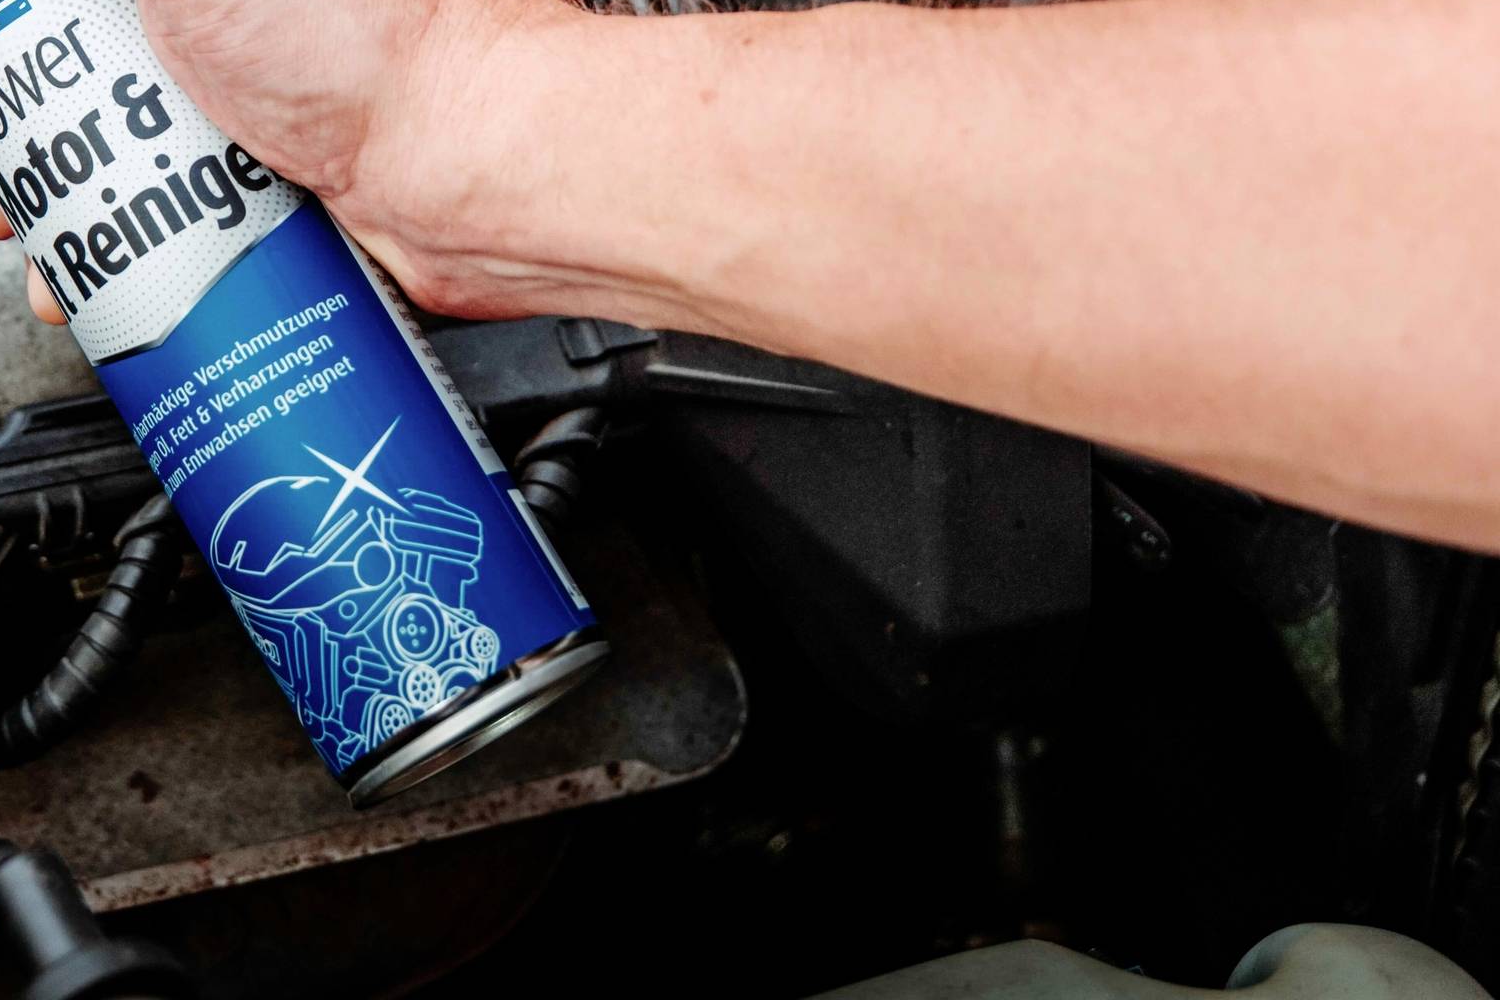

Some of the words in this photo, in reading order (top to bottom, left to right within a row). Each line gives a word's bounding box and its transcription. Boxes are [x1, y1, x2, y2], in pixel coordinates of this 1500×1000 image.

[111, 73, 173, 141] &
[53, 142, 286, 302] Reinige
[31, 253, 78, 323] lt
[133, 380, 197, 441] hartnäckige
[193, 293, 349, 387] Verschmutzungen
[155, 435, 175, 457] Öl,
[169, 415, 199, 446] Fett
[196, 406, 211, 425] &
[208, 334, 334, 414] Verharzungen
[167, 467, 188, 492] zum
[182, 404, 273, 475] Entwachsen
[273, 355, 356, 416] geeignet
